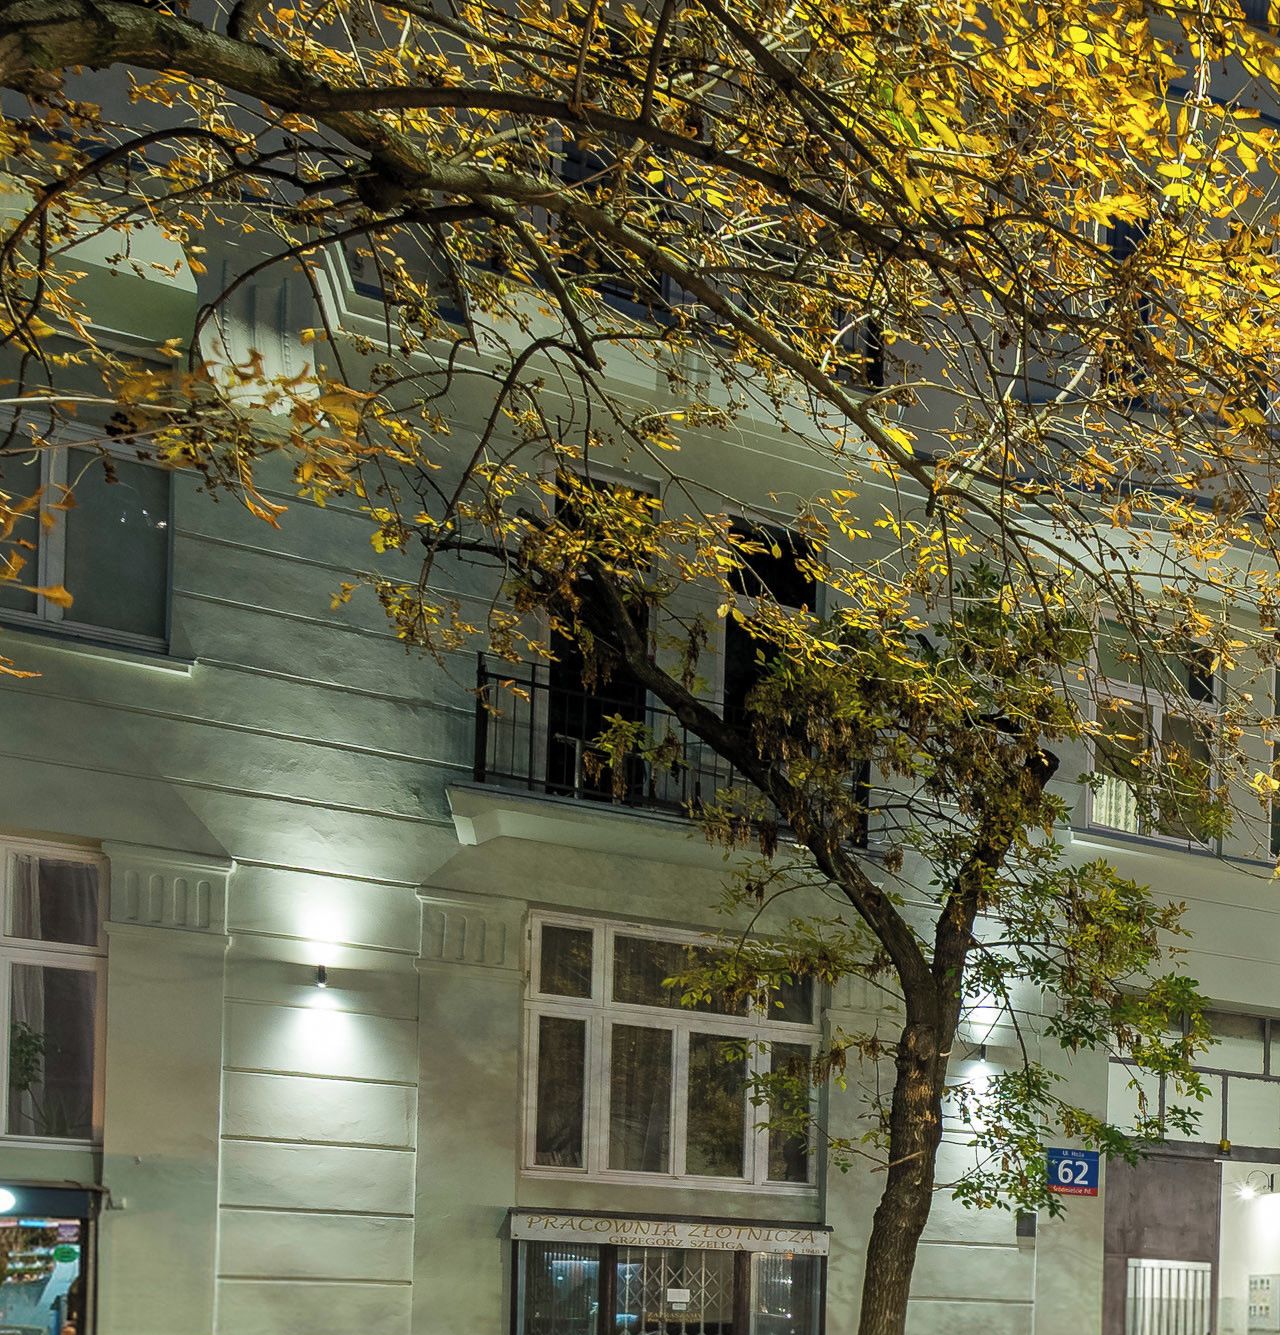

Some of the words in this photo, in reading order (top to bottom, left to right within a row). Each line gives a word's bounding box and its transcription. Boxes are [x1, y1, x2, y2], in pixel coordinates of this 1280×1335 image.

[1058, 1159, 1089, 1185] 62
[527, 1214, 677, 1236] PRACOWNIA
[688, 1224, 816, 1244] ZŁOTNICZA
[608, 1235, 683, 1248] GRZEGORZ
[690, 1239, 744, 1250] SZELIGA
